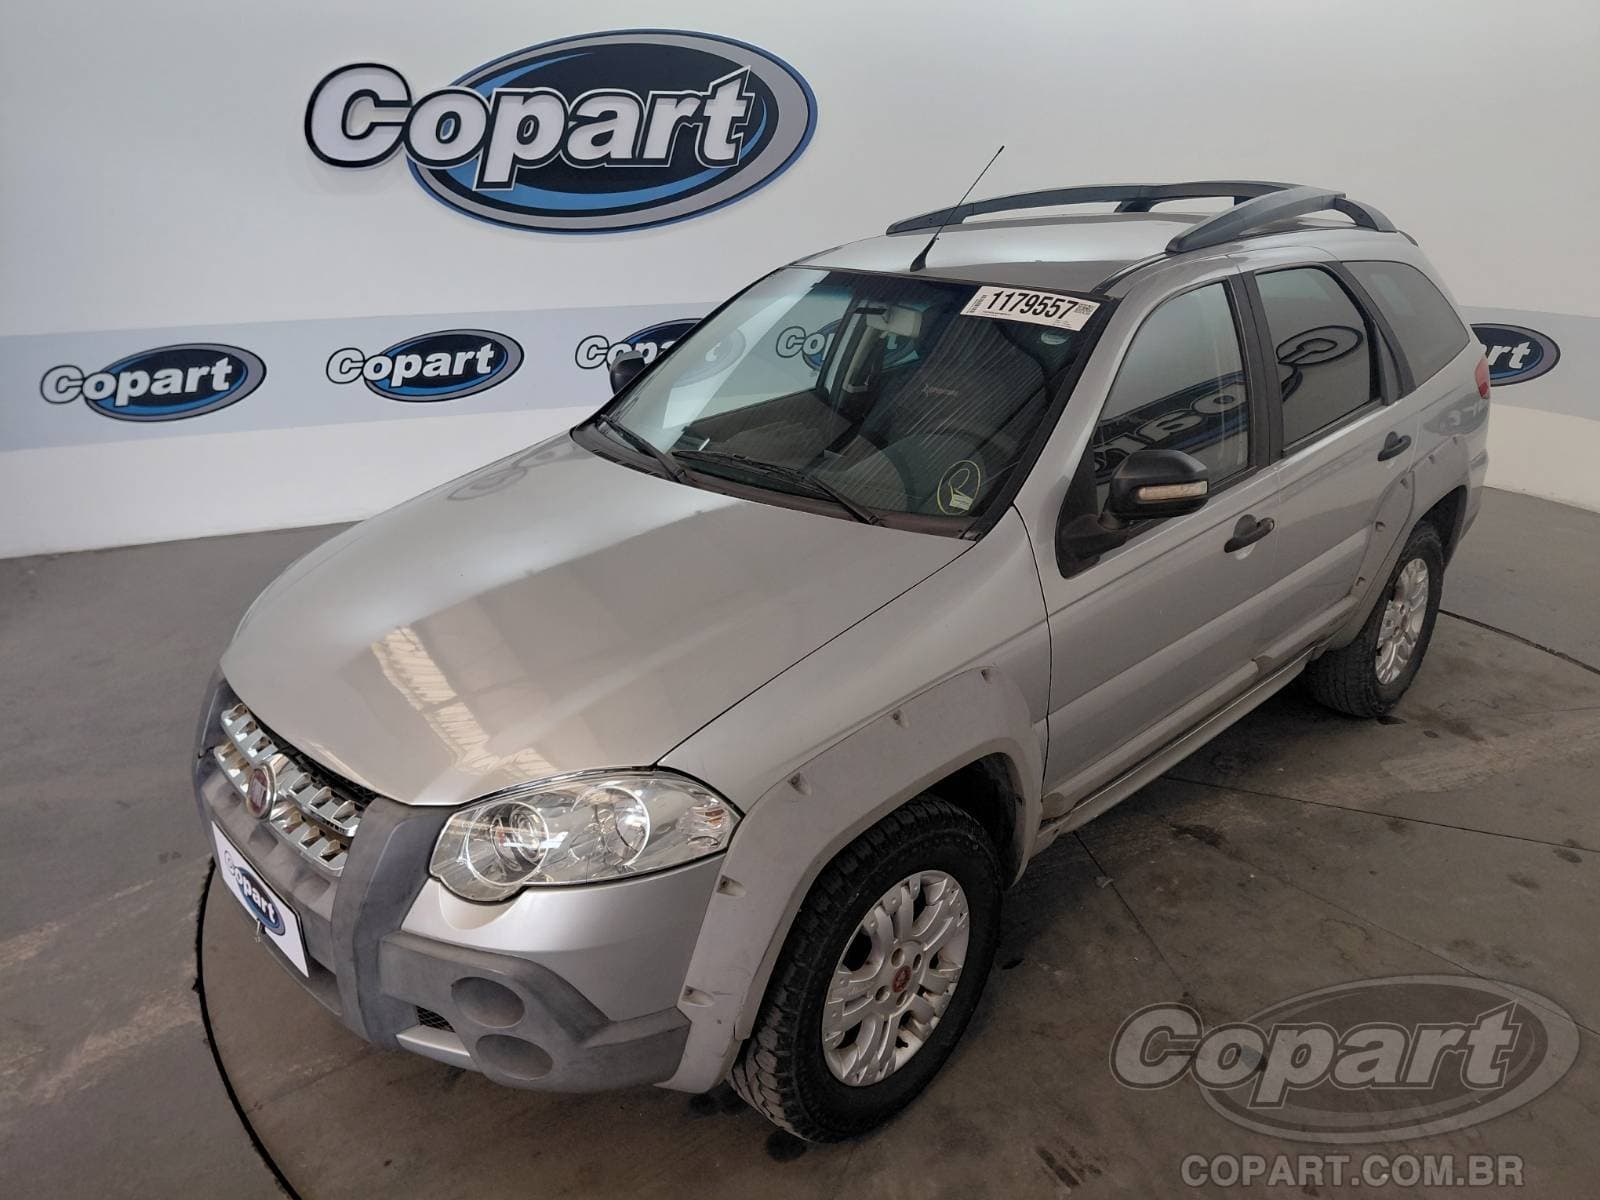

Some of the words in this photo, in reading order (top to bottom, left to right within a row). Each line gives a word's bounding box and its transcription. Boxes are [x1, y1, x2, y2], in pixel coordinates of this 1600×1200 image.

[305, 62, 756, 191] Copart
[987, 290, 1079, 320] 1179557
[40, 356, 234, 407] Copart
[326, 343, 495, 387] Copart
[223, 850, 277, 923] Copart
